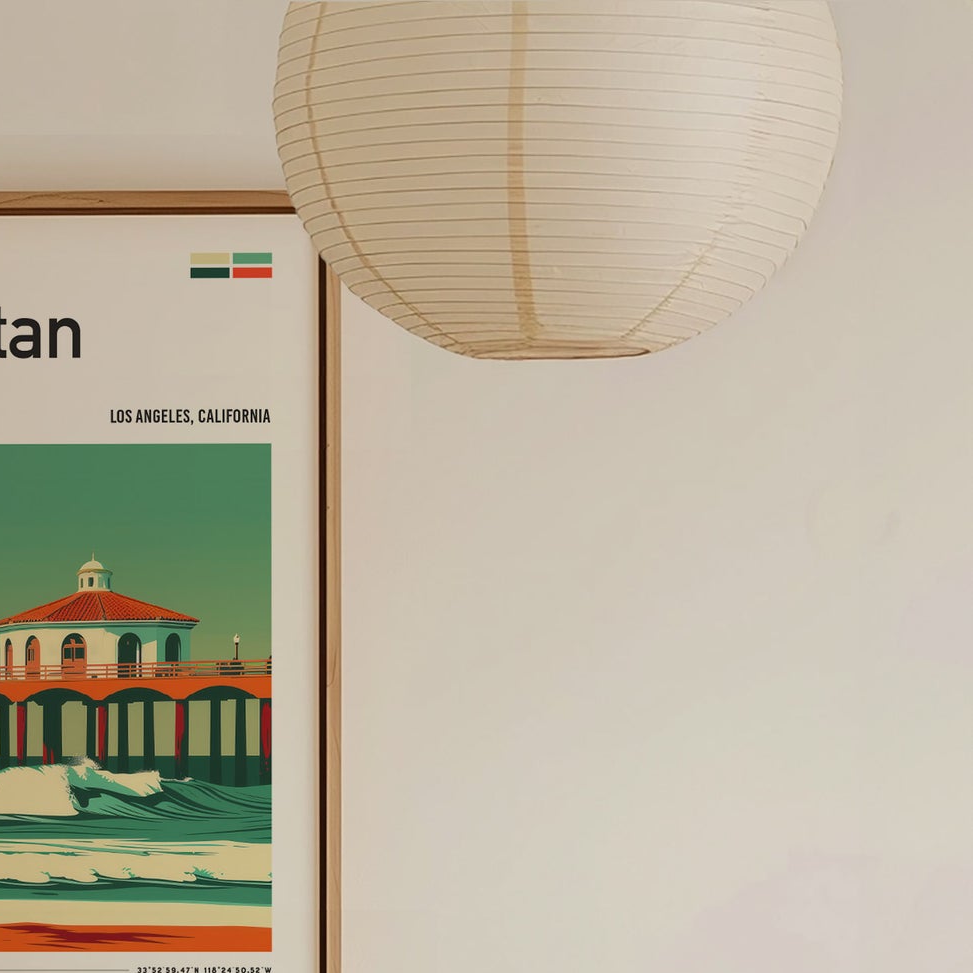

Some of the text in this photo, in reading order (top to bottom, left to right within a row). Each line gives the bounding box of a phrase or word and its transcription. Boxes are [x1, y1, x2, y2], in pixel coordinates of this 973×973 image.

[111, 409, 270, 425] LOS ANGELES, CALIFORNIA
